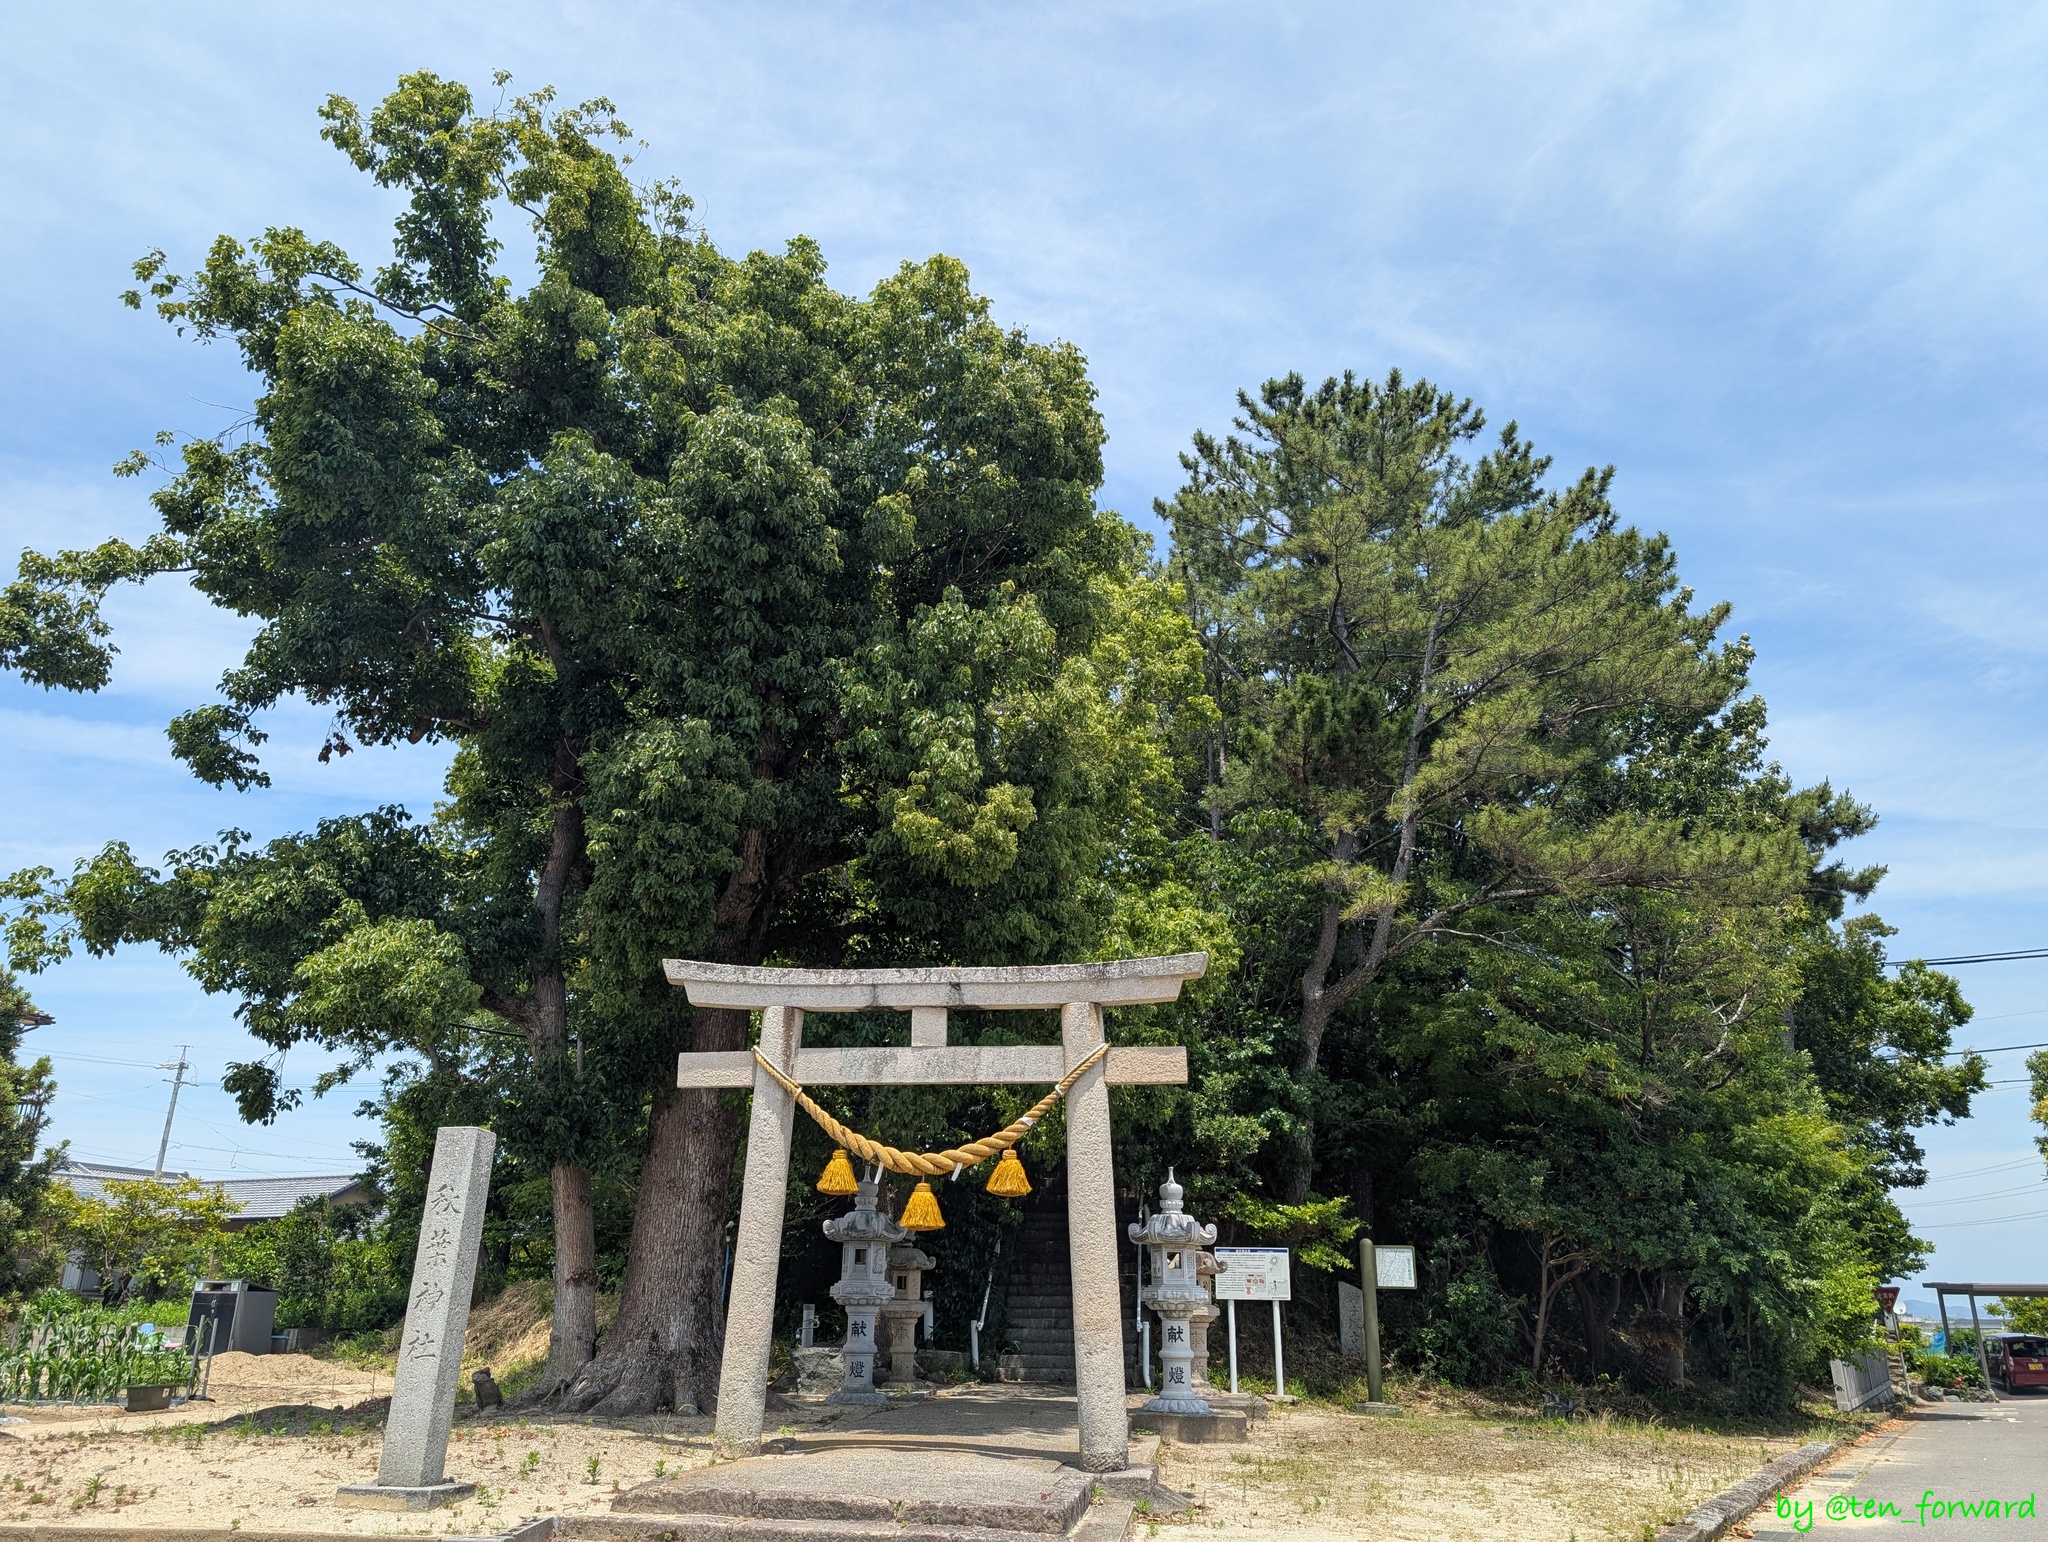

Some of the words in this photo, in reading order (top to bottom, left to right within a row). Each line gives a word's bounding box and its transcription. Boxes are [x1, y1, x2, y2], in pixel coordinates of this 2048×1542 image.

[405, 1183, 462, 1361] 秋葉神社
[849, 1321, 867, 1378] 献燈
[1167, 1325, 1186, 1384] 献燈
